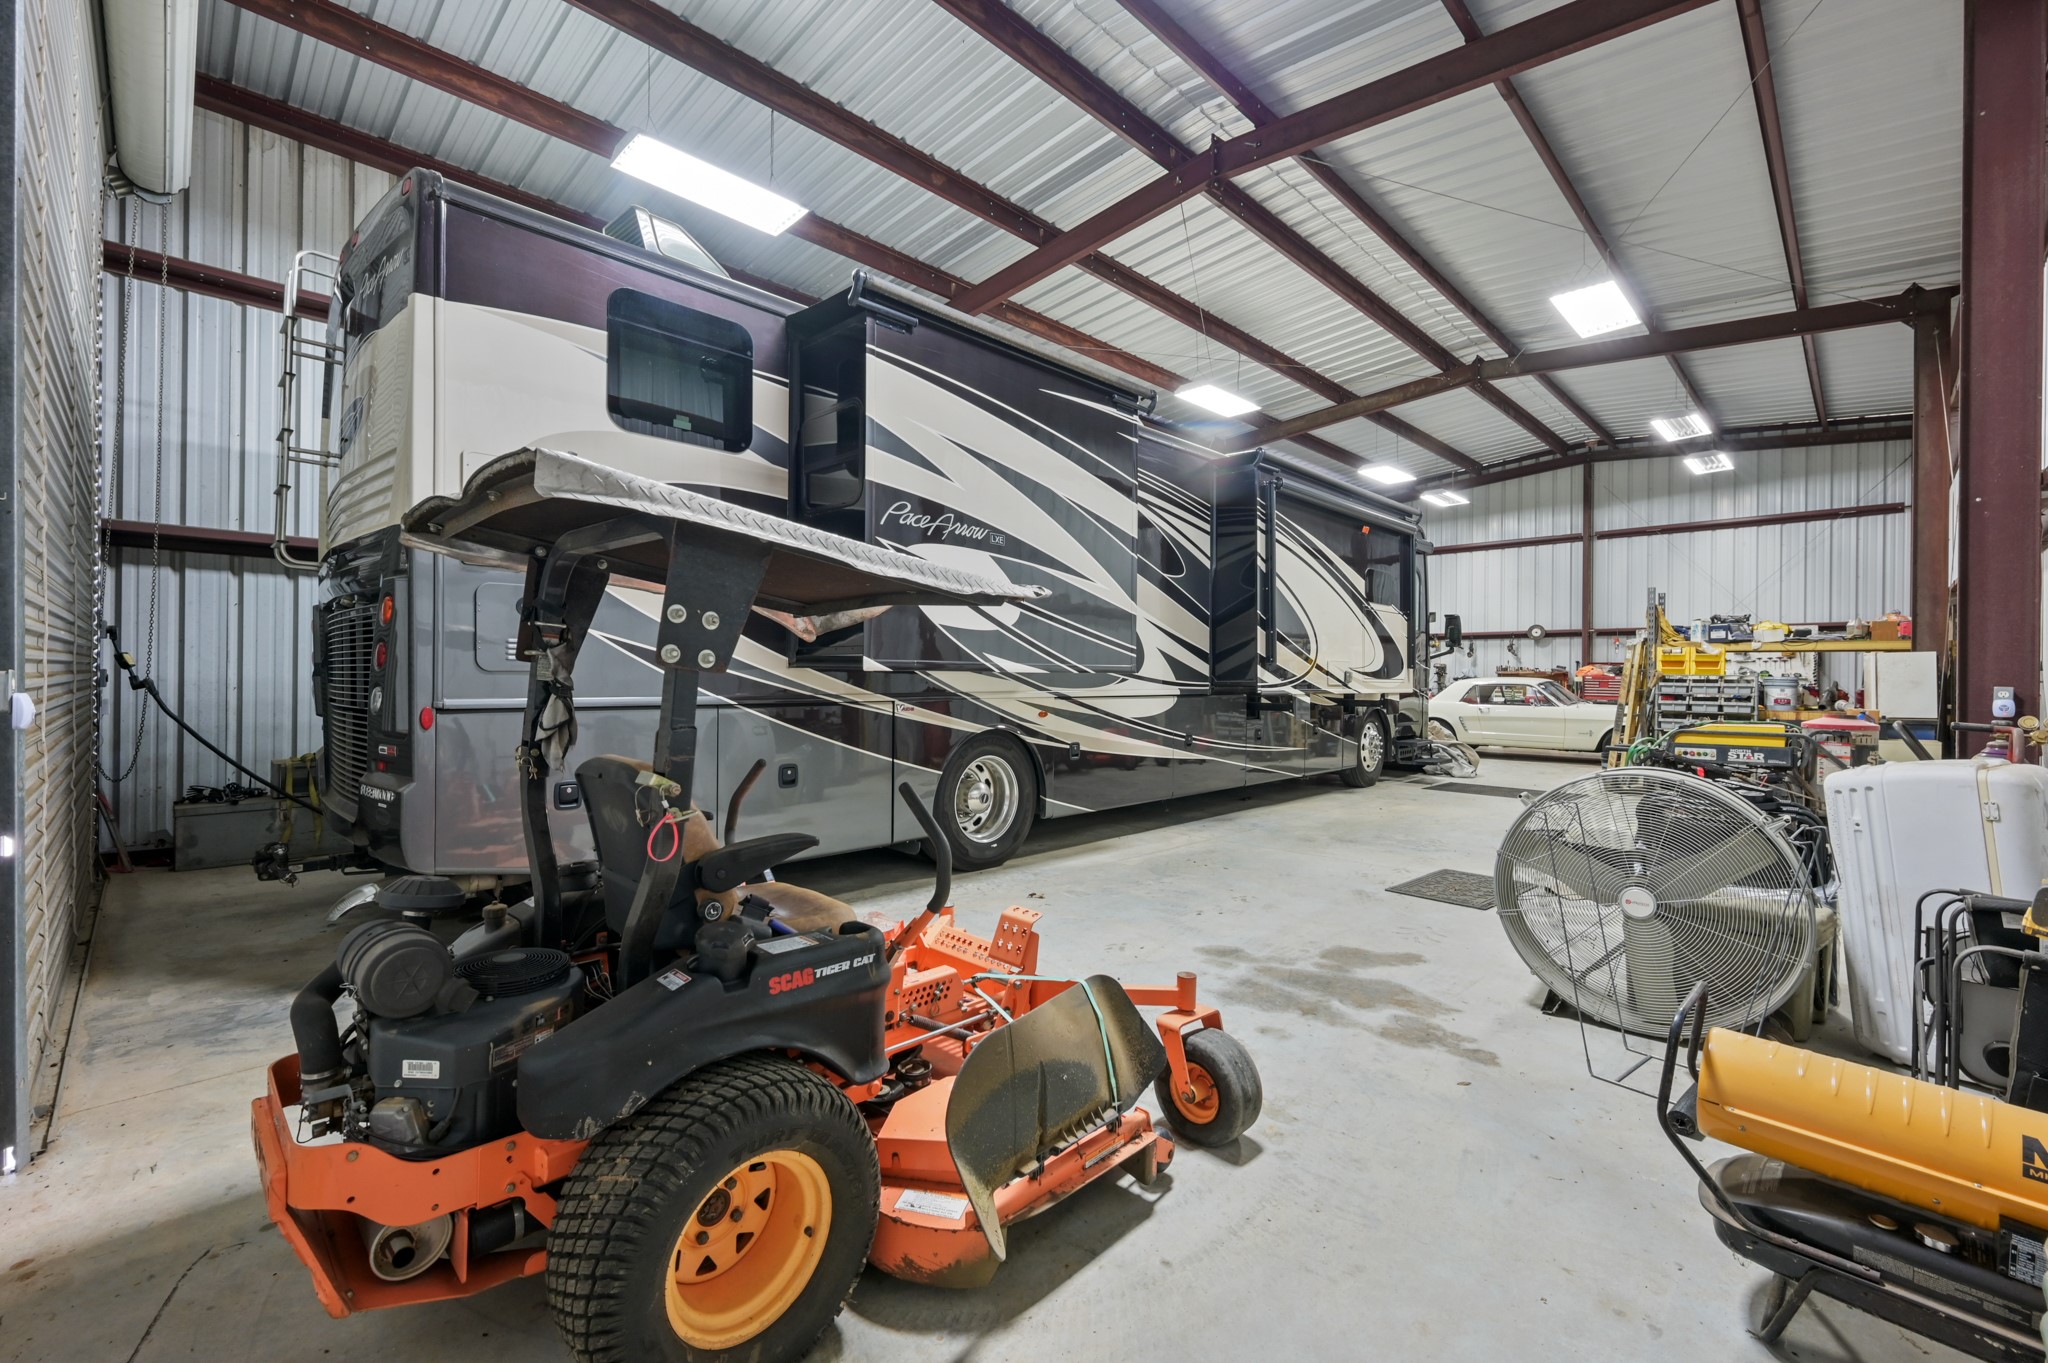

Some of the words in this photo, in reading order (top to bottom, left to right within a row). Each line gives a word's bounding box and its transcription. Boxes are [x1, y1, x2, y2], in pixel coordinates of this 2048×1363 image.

[991, 534, 1004, 545] LXE
[1728, 752, 1765, 761] STAR
[769, 967, 814, 995] SCAG
[814, 960, 850, 979] TIGER
[853, 953, 876, 968] CAT
